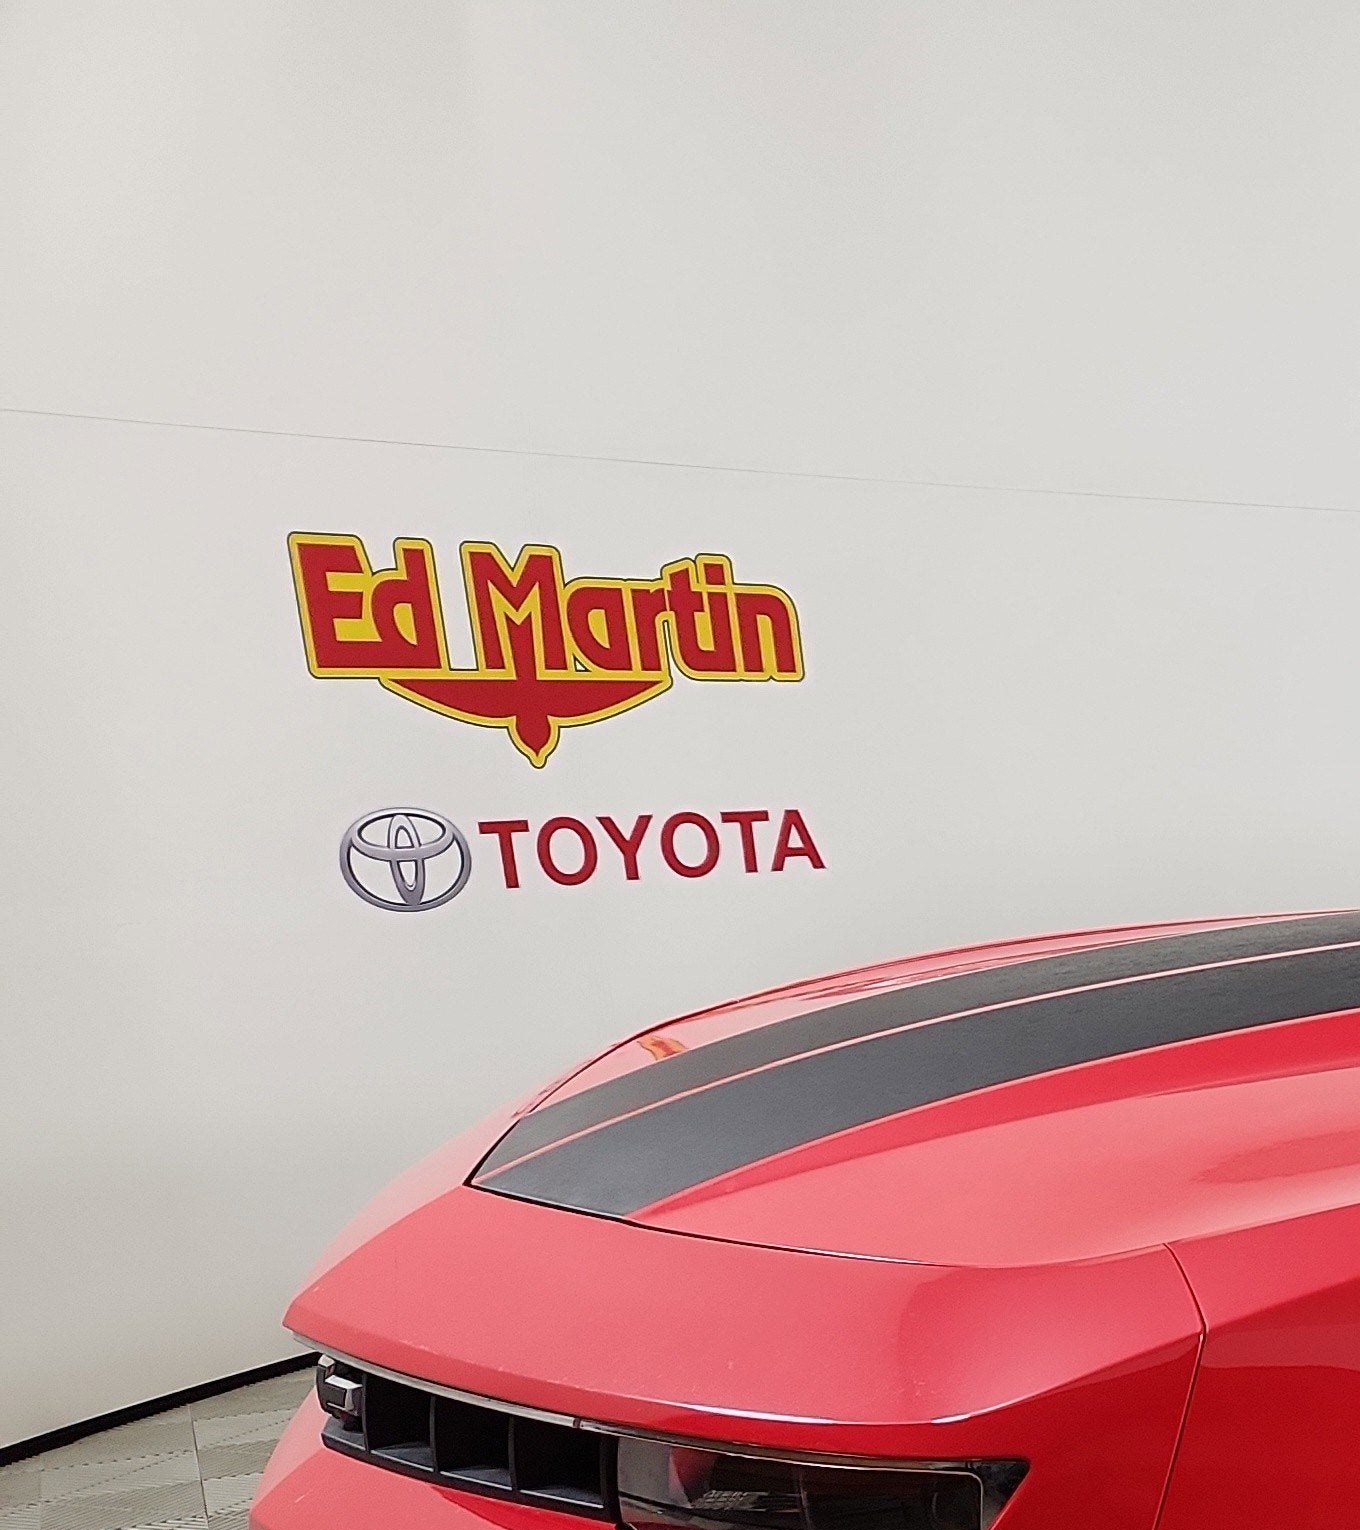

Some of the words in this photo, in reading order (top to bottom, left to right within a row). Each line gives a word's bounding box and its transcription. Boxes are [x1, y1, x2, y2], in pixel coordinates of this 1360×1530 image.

[293, 537, 446, 673] Ed
[463, 544, 801, 676] Martin
[478, 809, 826, 889] TOYOTA
